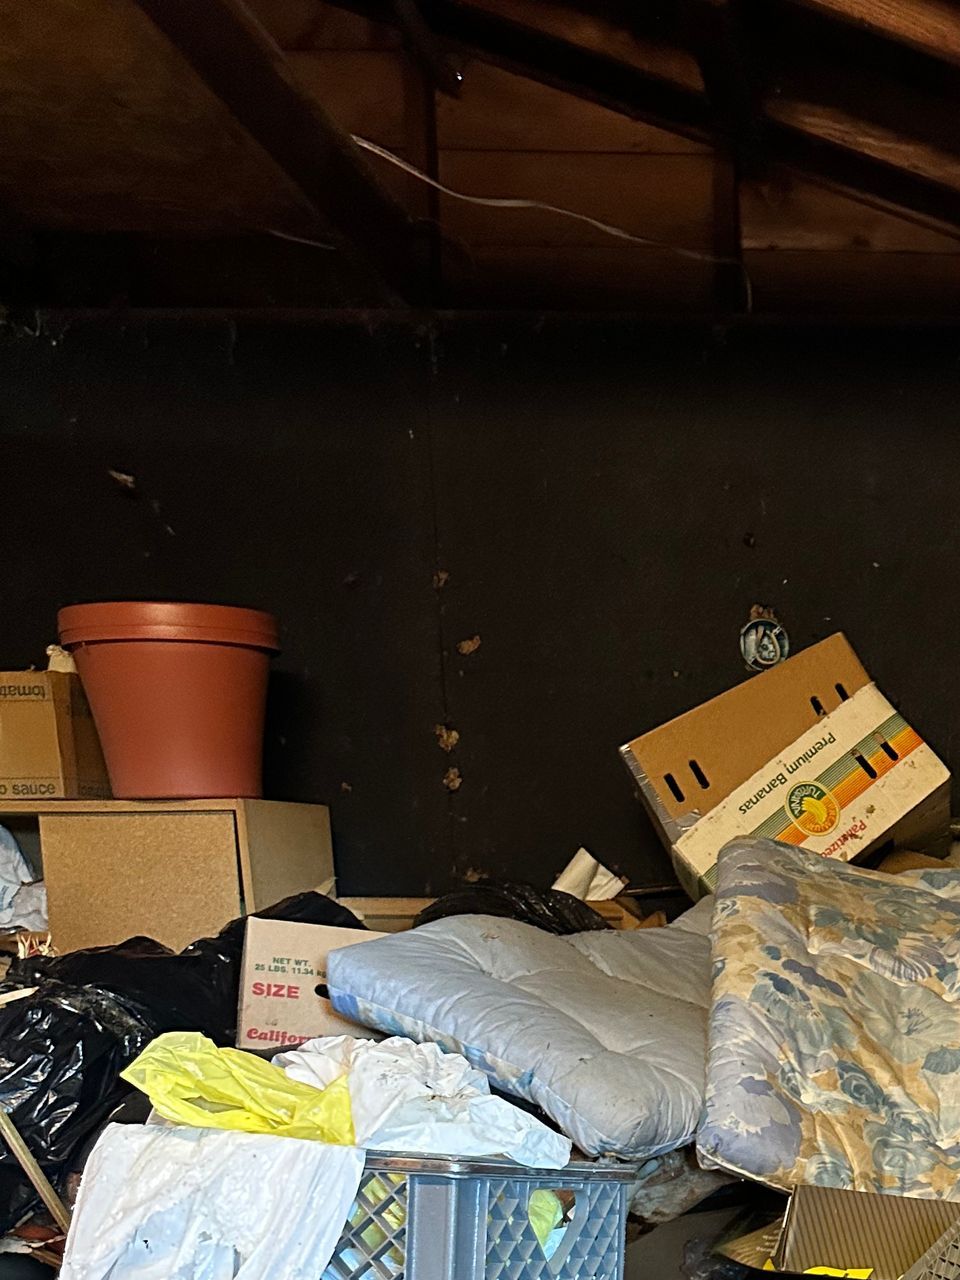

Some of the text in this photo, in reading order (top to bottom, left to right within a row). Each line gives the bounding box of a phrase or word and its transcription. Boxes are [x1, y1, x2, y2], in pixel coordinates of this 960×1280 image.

[738, 732, 836, 815] Premium Bananas
[12, 784, 56, 795] sauce
[273, 957, 311, 967] NET WT.
[268, 965, 289, 973] LBS.
[292, 967, 314, 976] 11.34
[252, 982, 300, 999] SIZE
